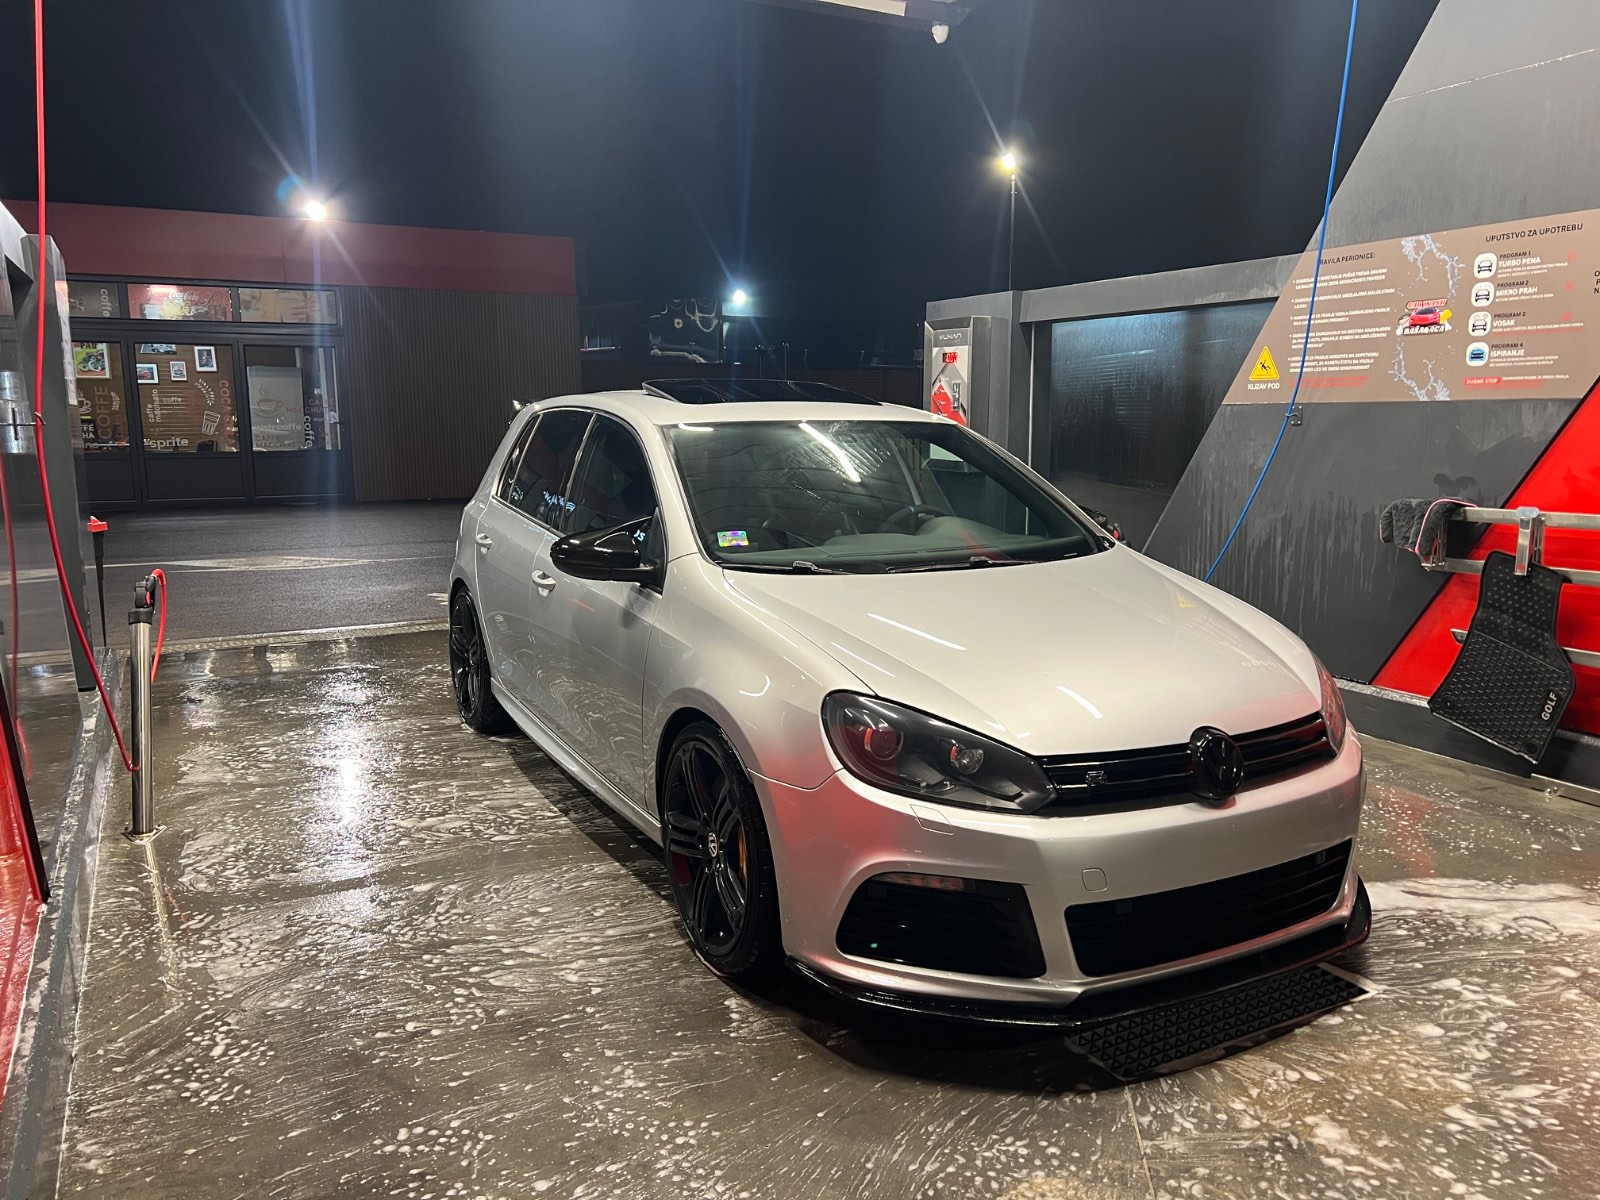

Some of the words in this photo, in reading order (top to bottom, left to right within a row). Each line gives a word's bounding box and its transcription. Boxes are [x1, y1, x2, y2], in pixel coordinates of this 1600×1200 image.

[1485, 231, 1526, 243] UPUTSTVO
[1527, 229, 1538, 237] ZA
[1539, 223, 1584, 236] UPOTREBU
[1320, 257, 1340, 265] RAVILA
[1499, 251, 1527, 259] PROGRAM
[1498, 258, 1521, 268] TURBO
[1522, 257, 1541, 265] PENA
[1497, 280, 1523, 288] PROGRAM
[1496, 288, 1518, 297] MIKRO
[1518, 286, 1538, 295] PRAH
[100, 289, 112, 317] coffe
[94, 386, 112, 440] COFFE
[277, 422, 302, 431] coffe
[303, 415, 315, 448] coffe
[150, 437, 189, 450] sprite
[1541, 691, 1558, 721] GOLF
